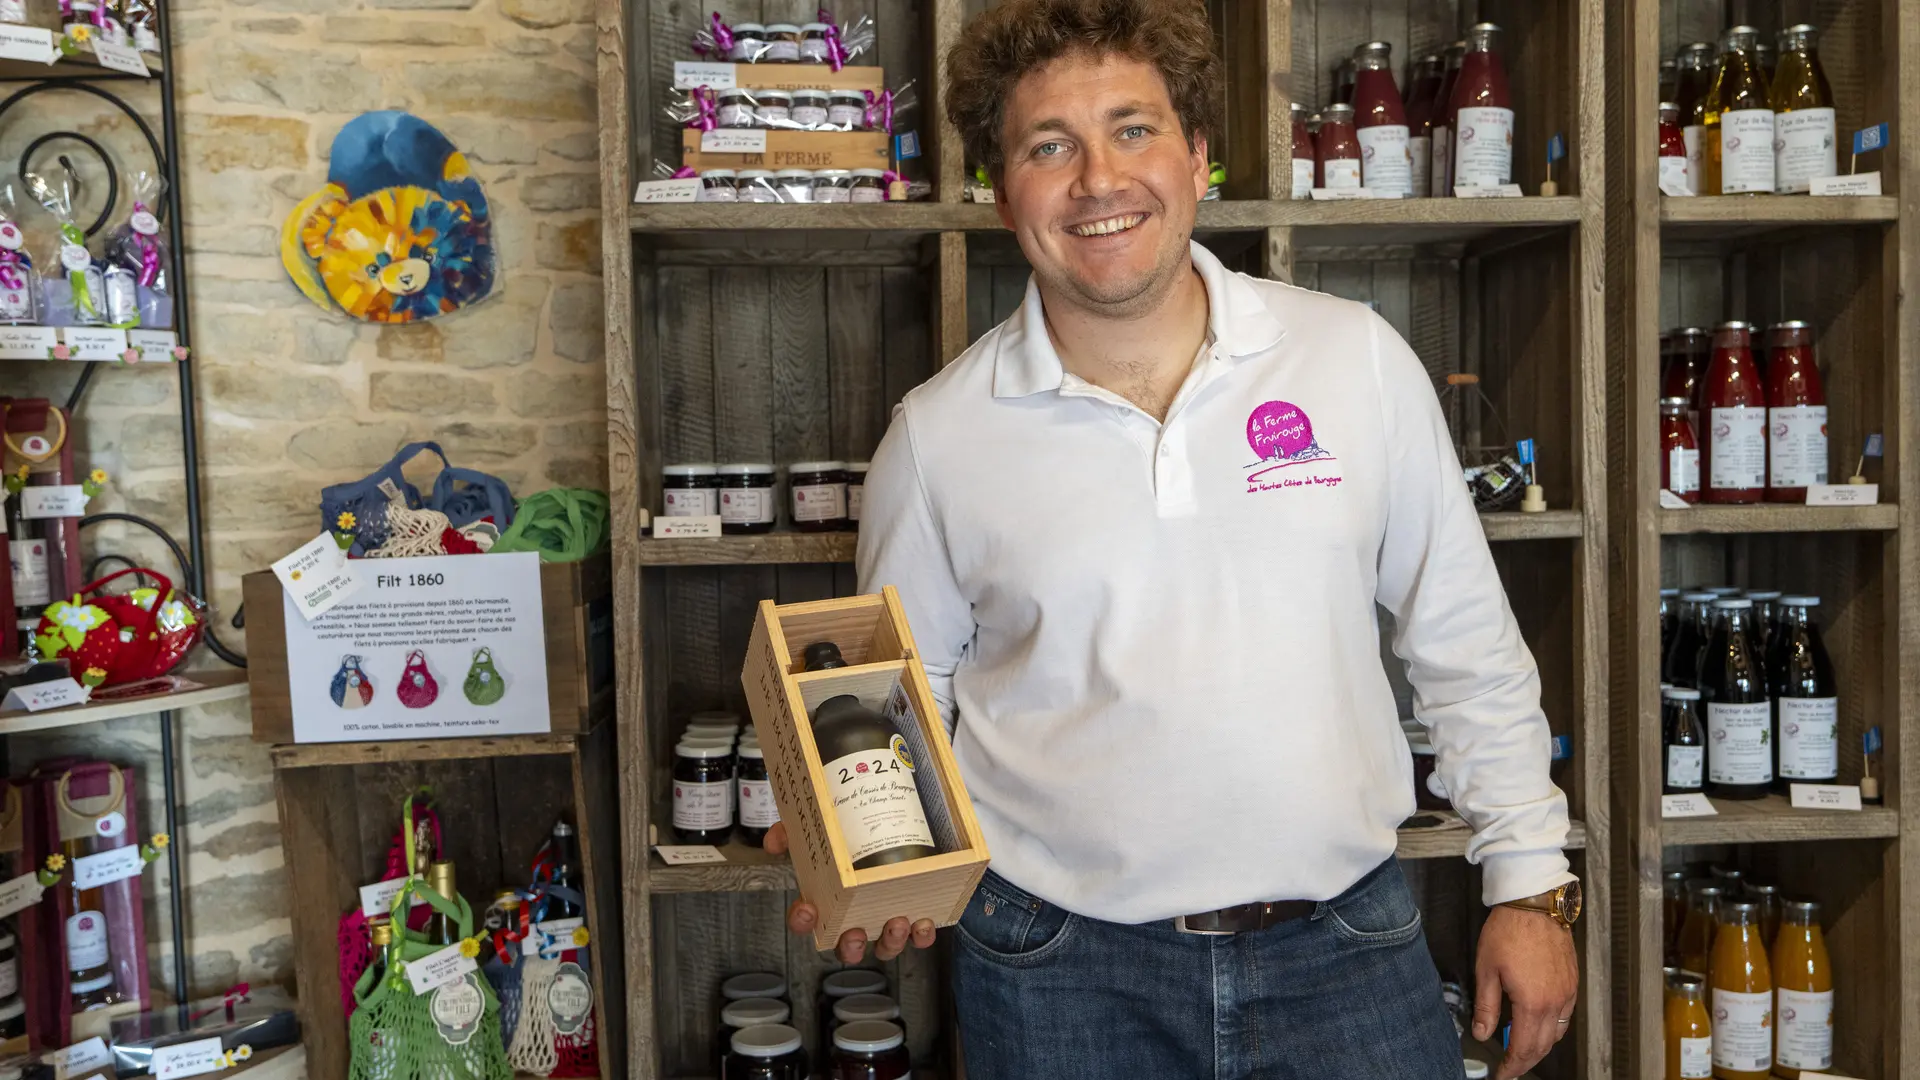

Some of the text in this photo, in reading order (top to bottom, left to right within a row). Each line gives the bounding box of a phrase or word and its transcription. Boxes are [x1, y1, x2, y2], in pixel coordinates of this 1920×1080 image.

[774, 151, 832, 165] FERME
[1264, 410, 1298, 428] Ferme
[1254, 422, 1306, 446] Fruirouge
[1260, 481, 1282, 492] Hautes
[1314, 476, 1342, 487] Bourgogne
[378, 572, 444, 588] Filt 1860
[394, 601, 424, 610] provisions
[426, 600, 446, 608] depuis
[448, 598, 464, 606] 1860
[476, 608, 502, 616] pratique
[398, 619, 428, 628] tellement
[318, 631, 354, 640] couturières
[433, 628, 460, 636] prénoms
[378, 640, 410, 648] provisions
[436, 637, 469, 645] fabriquent
[772, 717, 818, 870] BOURGOGNE
[802, 776, 832, 865] CASSIS
[980, 887, 1008, 908] GANT
